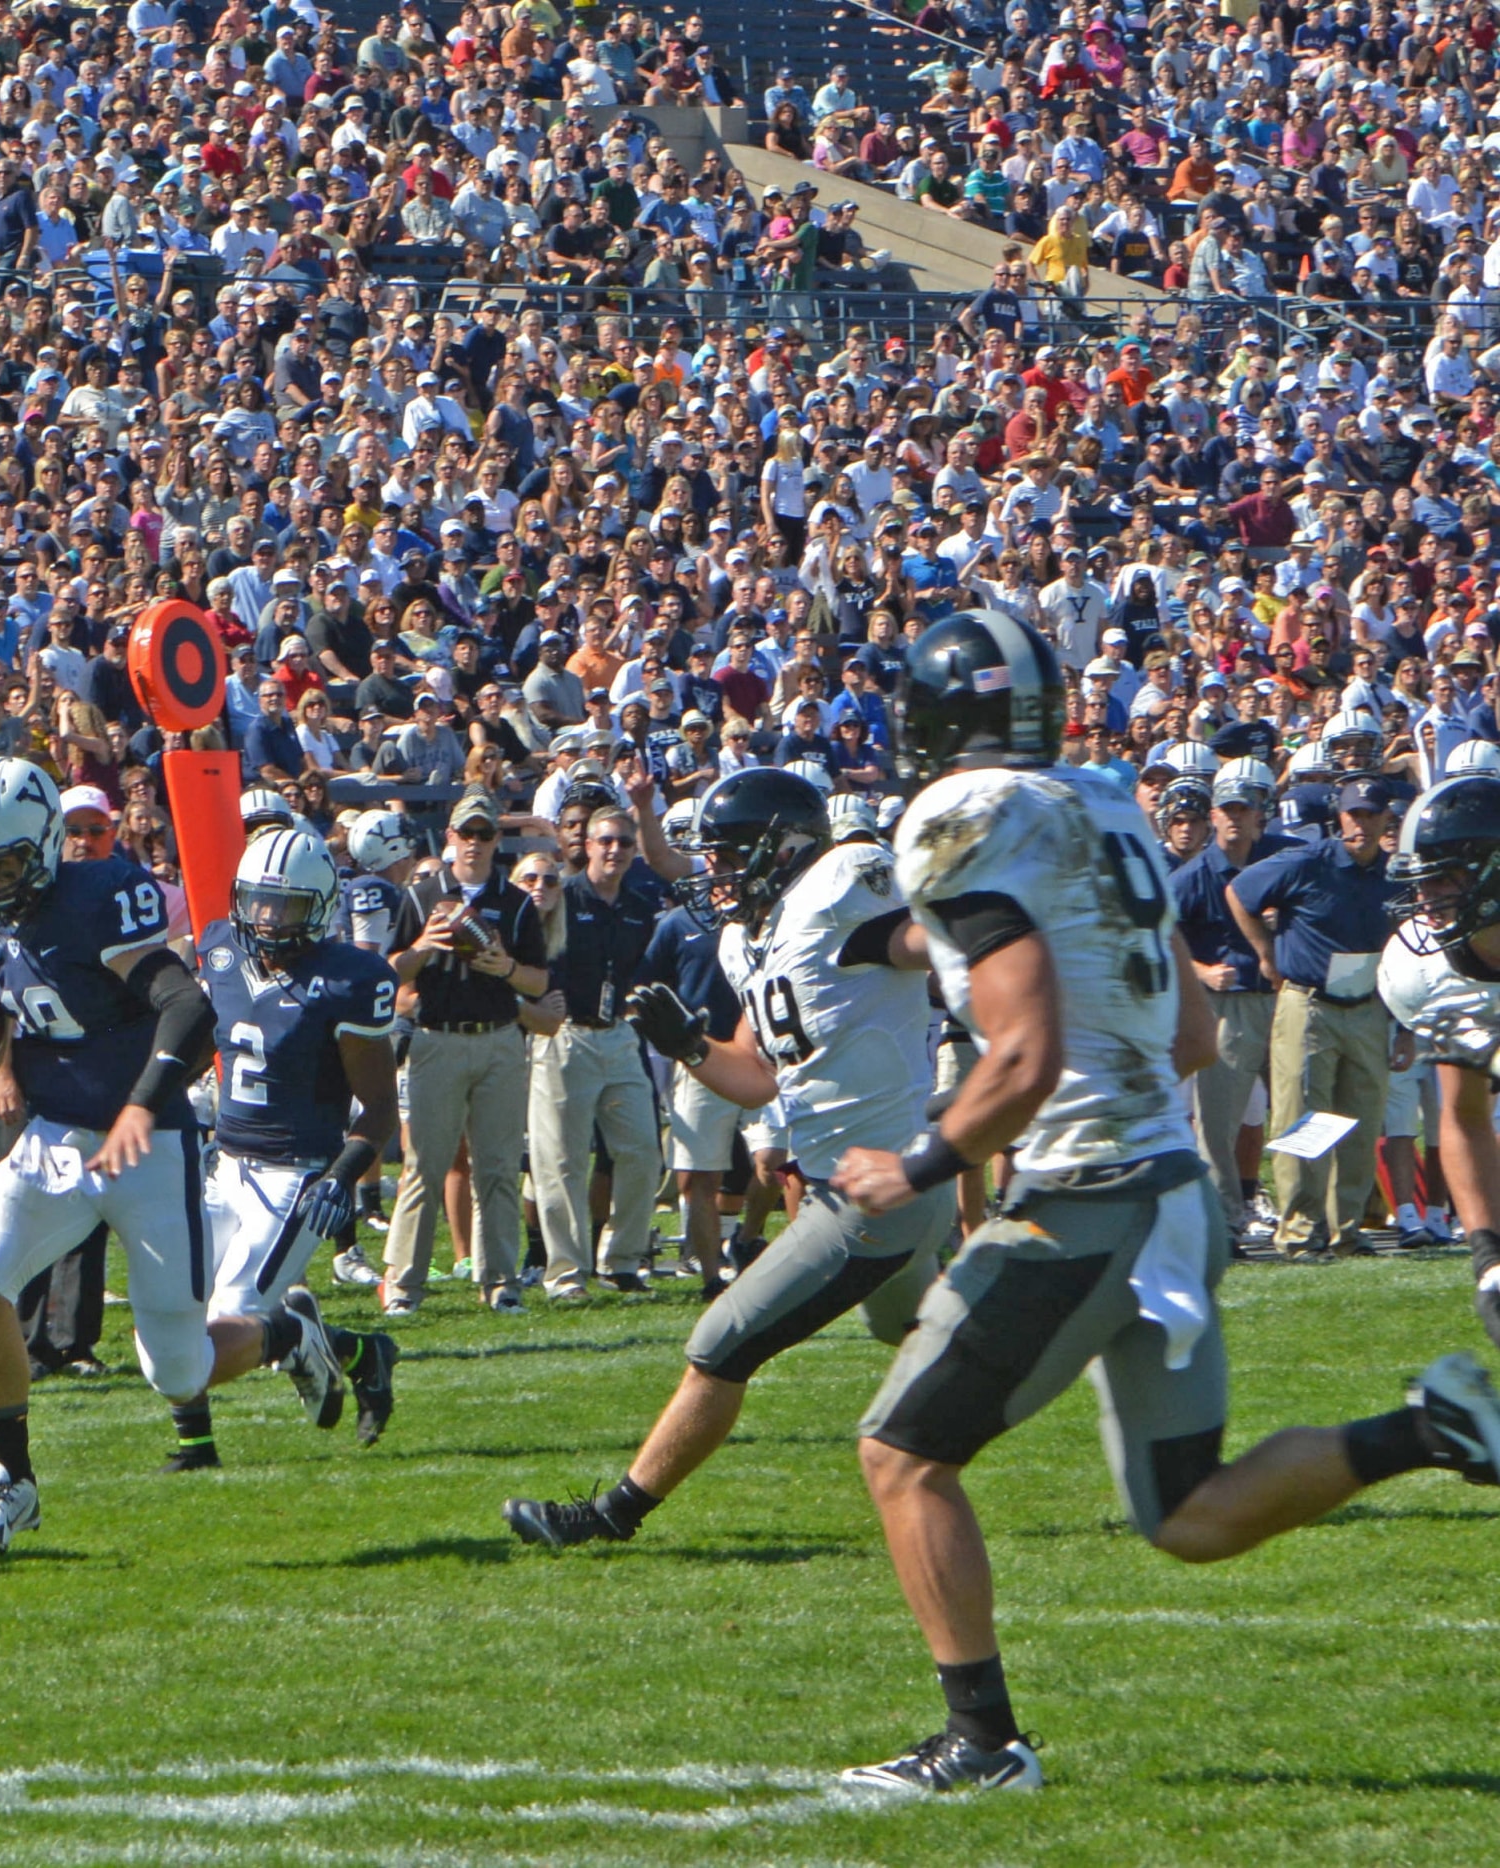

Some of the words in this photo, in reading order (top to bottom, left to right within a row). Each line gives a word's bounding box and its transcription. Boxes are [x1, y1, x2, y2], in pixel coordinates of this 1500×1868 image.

[993, 303, 1017, 317] YALE
[845, 590, 876, 604] YALE
[1067, 596, 1091, 623] Y
[1130, 617, 1158, 631] YALE
[1356, 783, 1372, 798] Y
[1279, 799, 1302, 825] 71
[114, 882, 160, 937] 19
[351, 887, 385, 912] 22
[307, 975, 325, 999] C
[373, 980, 396, 1019] 2
[228, 1021, 268, 1106] 2
